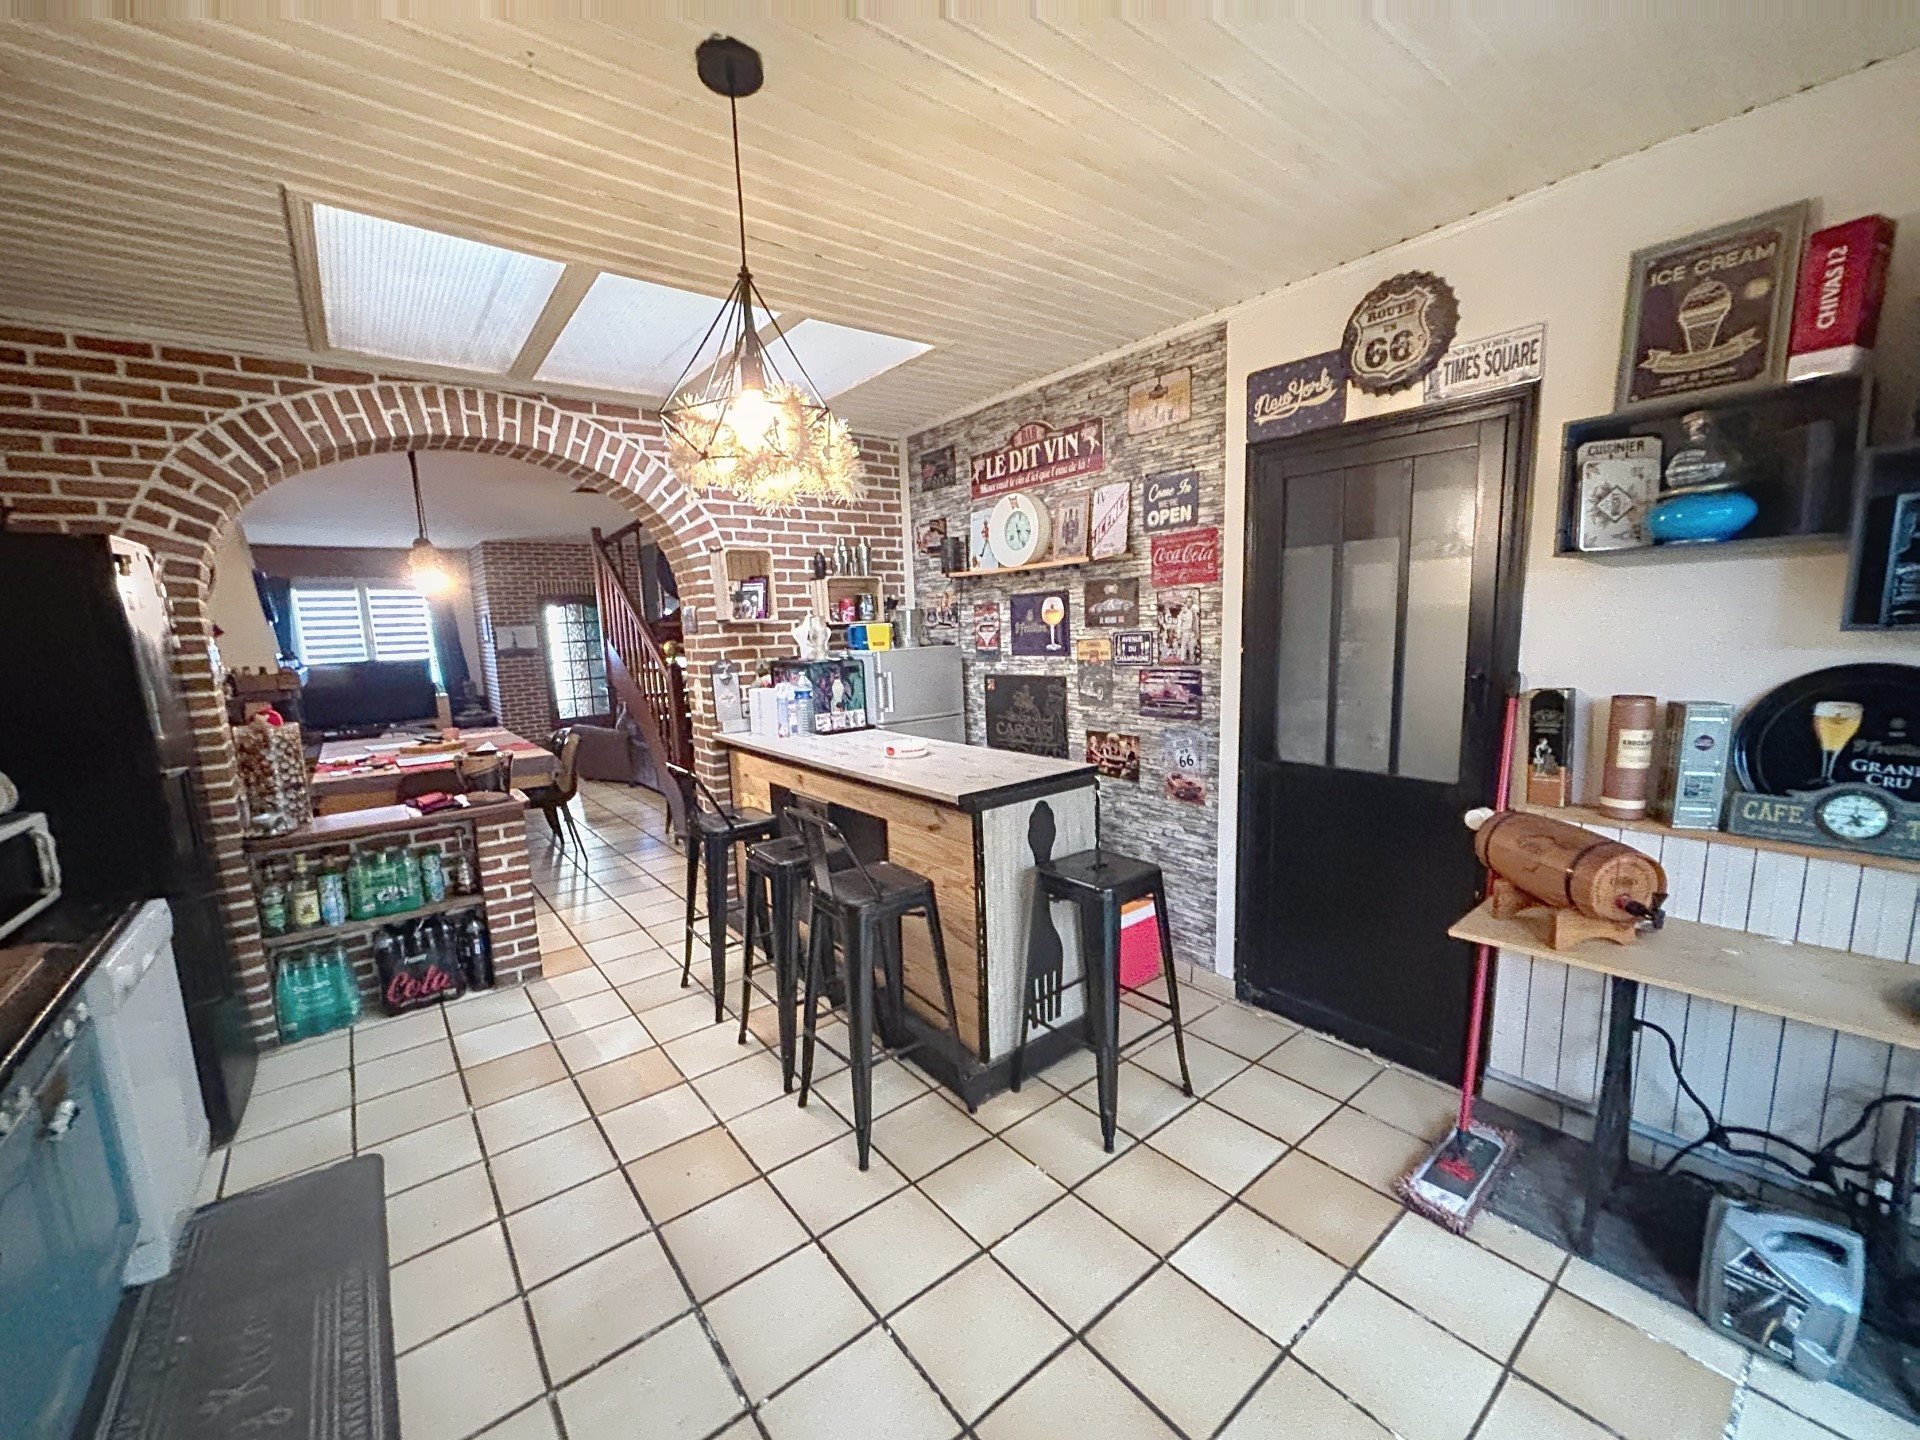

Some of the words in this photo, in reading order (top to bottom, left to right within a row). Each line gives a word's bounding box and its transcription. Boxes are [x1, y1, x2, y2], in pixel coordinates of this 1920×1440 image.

[1650, 265, 1687, 287] ICE
[1694, 242, 1777, 275] CREAM
[1826, 245, 1849, 266] 12
[1366, 298, 1416, 323] ROUTE
[1816, 265, 1845, 330] CHIVAS
[1364, 329, 1414, 369] 66
[1443, 353, 1481, 386] TIMES
[1484, 338, 1540, 377] SQUARE
[1253, 391, 1293, 418] New
[1288, 367, 1335, 405] York
[985, 454, 1007, 480] LE
[1009, 443, 1040, 473] DIT
[1043, 431, 1080, 464] VIN
[1149, 483, 1176, 502] Come
[1177, 477, 1192, 495] In
[1147, 504, 1193, 527] OPEN
[1128, 645, 1136, 653] DU
[1179, 754, 1194, 768] 66
[1865, 773, 1913, 790] CRU
[387, 965, 452, 1003] Cola
